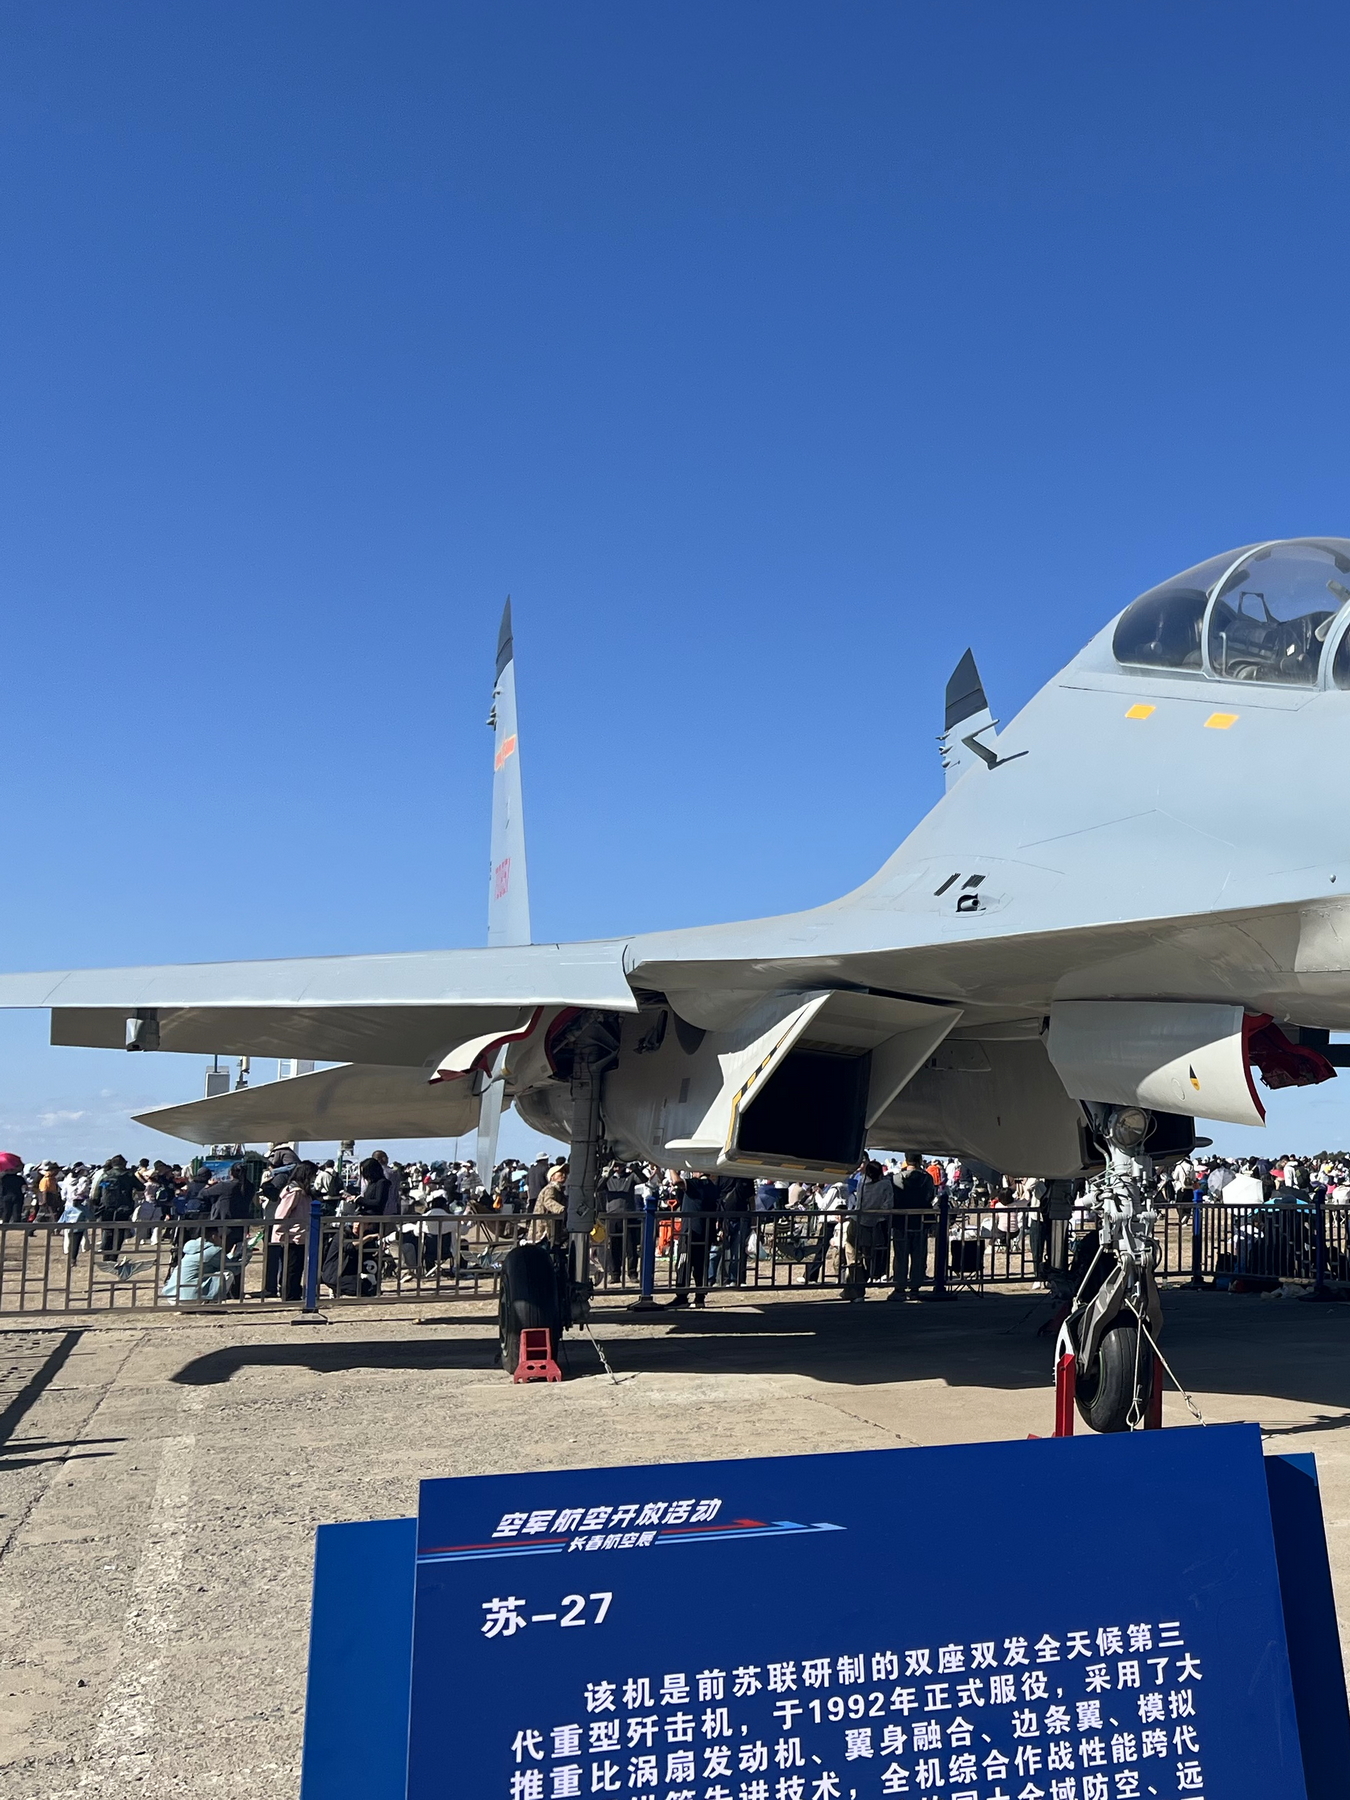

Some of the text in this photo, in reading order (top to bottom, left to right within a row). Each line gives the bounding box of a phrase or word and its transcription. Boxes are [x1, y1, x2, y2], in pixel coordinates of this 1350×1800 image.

[492, 1499, 722, 1537] 空军航空开放活动
[568, 1531, 657, 1552] 长春航空展
[481, 1592, 613, 1638] 苏-27
[584, 1621, 1184, 1714] 该机是前苏联研制的双座双发全天候第三
